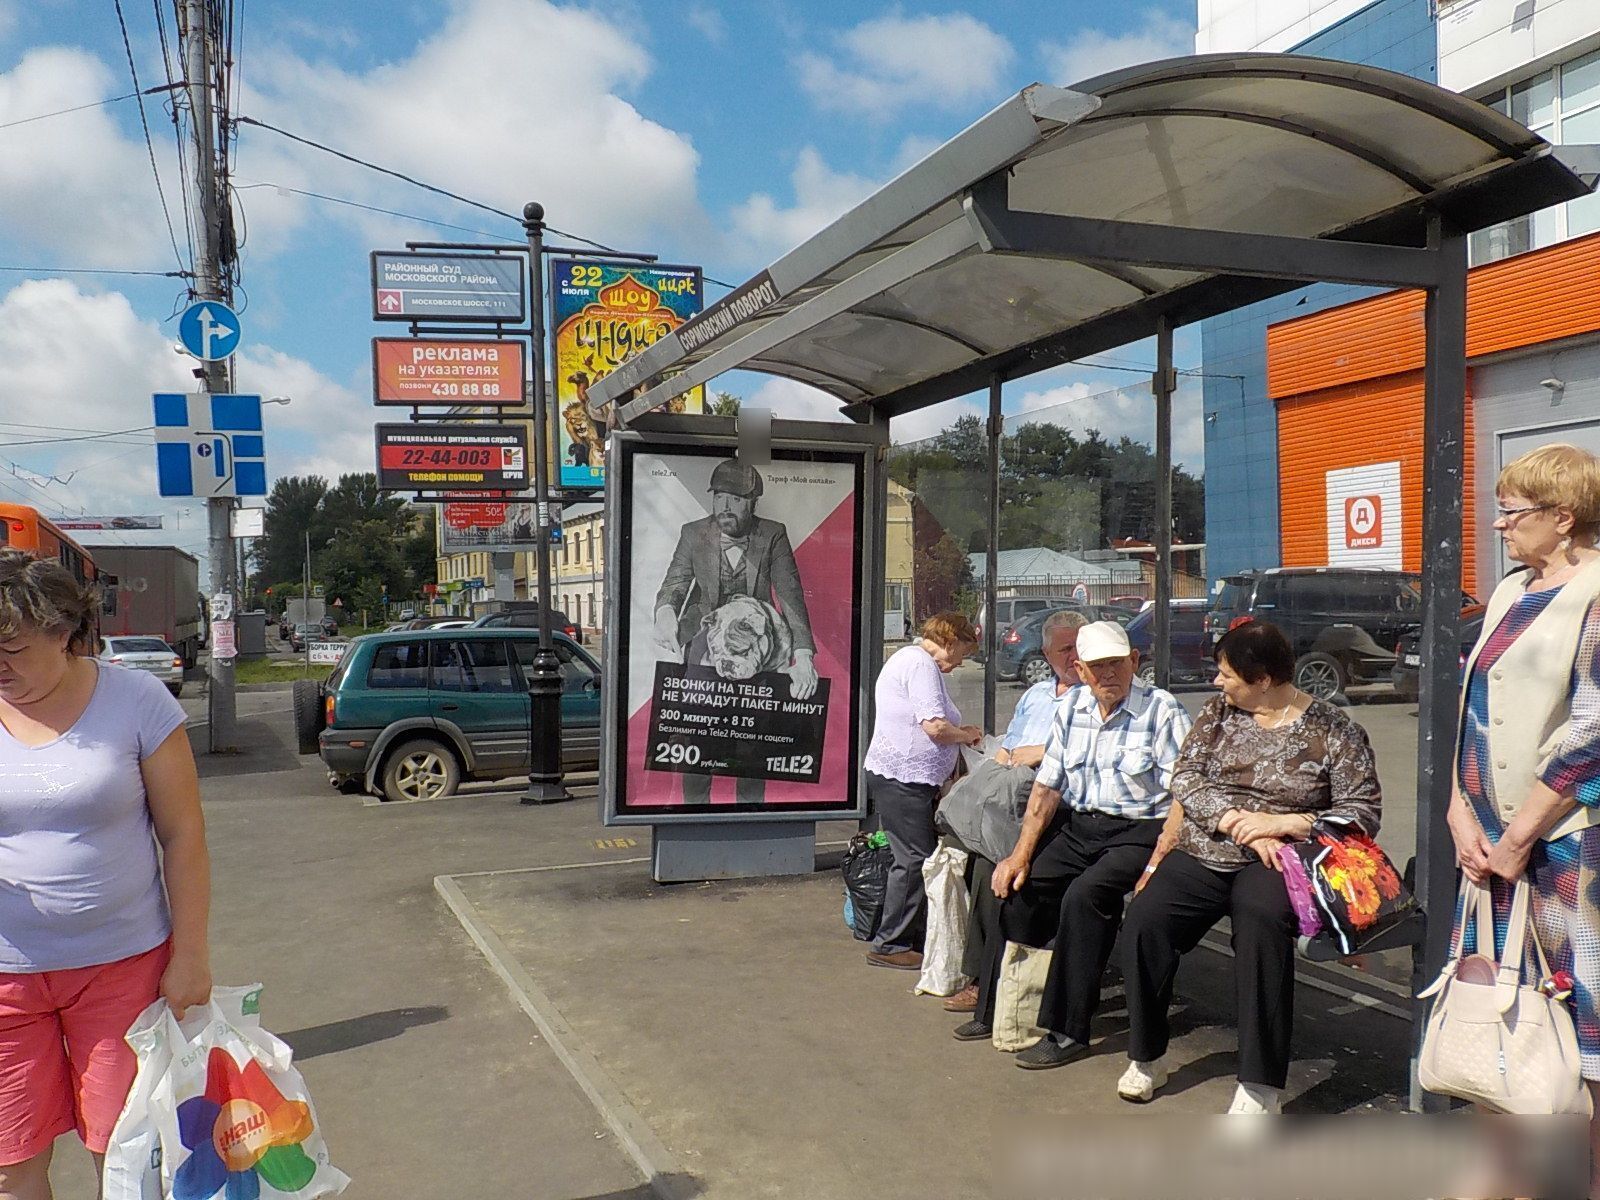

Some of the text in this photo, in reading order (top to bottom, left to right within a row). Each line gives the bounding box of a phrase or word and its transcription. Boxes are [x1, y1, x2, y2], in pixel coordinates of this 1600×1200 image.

[384, 262, 461, 275] РАЙОННЫЙ СУД
[571, 265, 603, 287] 22
[385, 272, 498, 285] МОСКОВСКОГО РАЙОНА
[411, 298, 462, 306] МОСКОВСКОЕ
[680, 280, 777, 351] СОРМОВСКИЙ ПОВОРОТ
[412, 346, 499, 364] реклама
[398, 364, 500, 378] на указателях
[432, 383, 458, 396] 430
[461, 383, 479, 396] 88
[482, 384, 500, 396] 88
[448, 436, 490, 444] ритуальная
[490, 436, 518, 444] служба
[402, 449, 491, 466] 22-44-003
[408, 472, 484, 482] телефон помощи
[651, 468, 677, 478] tele2.ru
[767, 475, 836, 485] Тариф «Мой онлайн»
[663, 677, 773, 698] ЗВОНКИ НА TELE2
[662, 690, 825, 716] НЕ УКРАДУТ ПАКЕТ МИНУТ
[660, 709, 681, 721] 300
[683, 713, 721, 727] минут
[731, 716, 739, 727] 8
[741, 716, 755, 728] Гб
[658, 723, 697, 735] Безлимит
[709, 728, 729, 738] Tele2
[730, 730, 756, 740] России
[764, 735, 794, 743] соцсети
[655, 742, 701, 765] 290
[766, 755, 814, 775] TELE2
